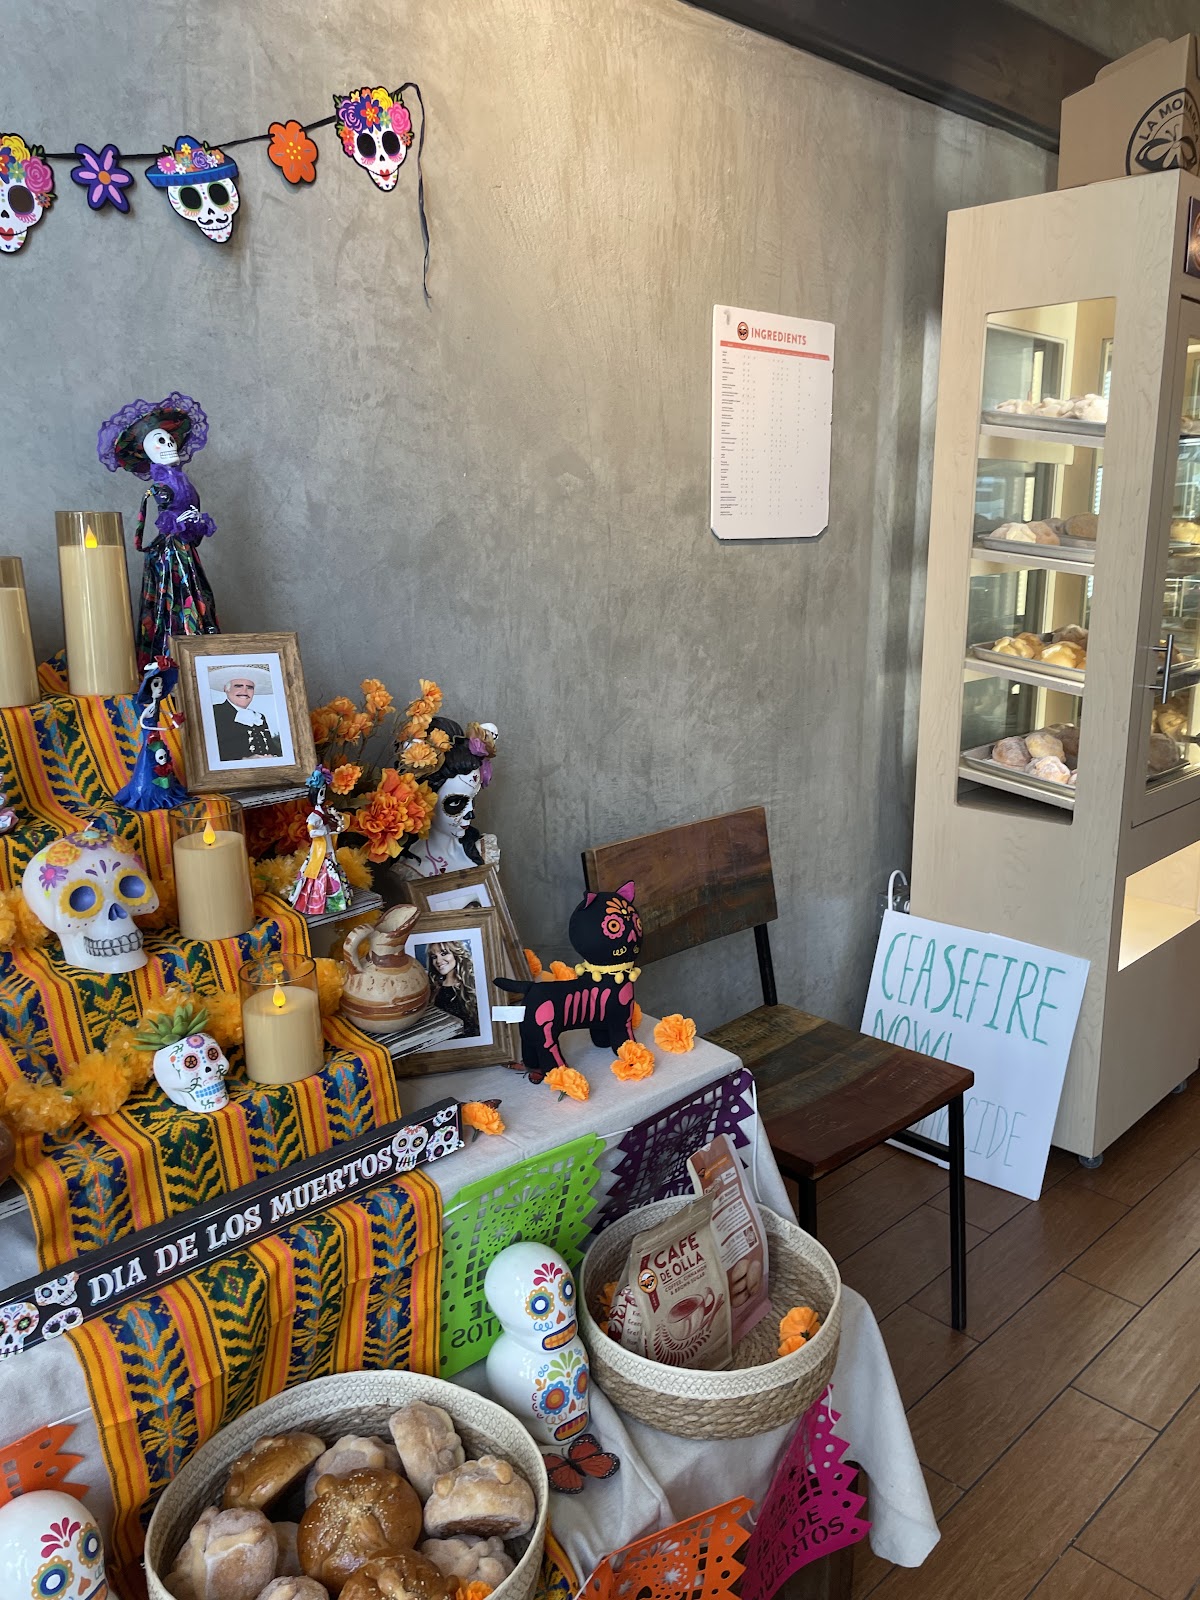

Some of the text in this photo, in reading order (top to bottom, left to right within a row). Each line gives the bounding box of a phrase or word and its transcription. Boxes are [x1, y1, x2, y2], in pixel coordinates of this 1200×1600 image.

[1139, 121, 1158, 141] LA
[751, 327, 807, 346] INGREDIENTS
[881, 932, 1066, 1046] CEASEFIRE
[88, 1145, 394, 1305] DIA DE LOS MUERTOS
[653, 1231, 699, 1269] CAFE
[660, 1270, 672, 1282] DE
[672, 1251, 704, 1276] OLLA
[792, 1505, 822, 1537] DE
